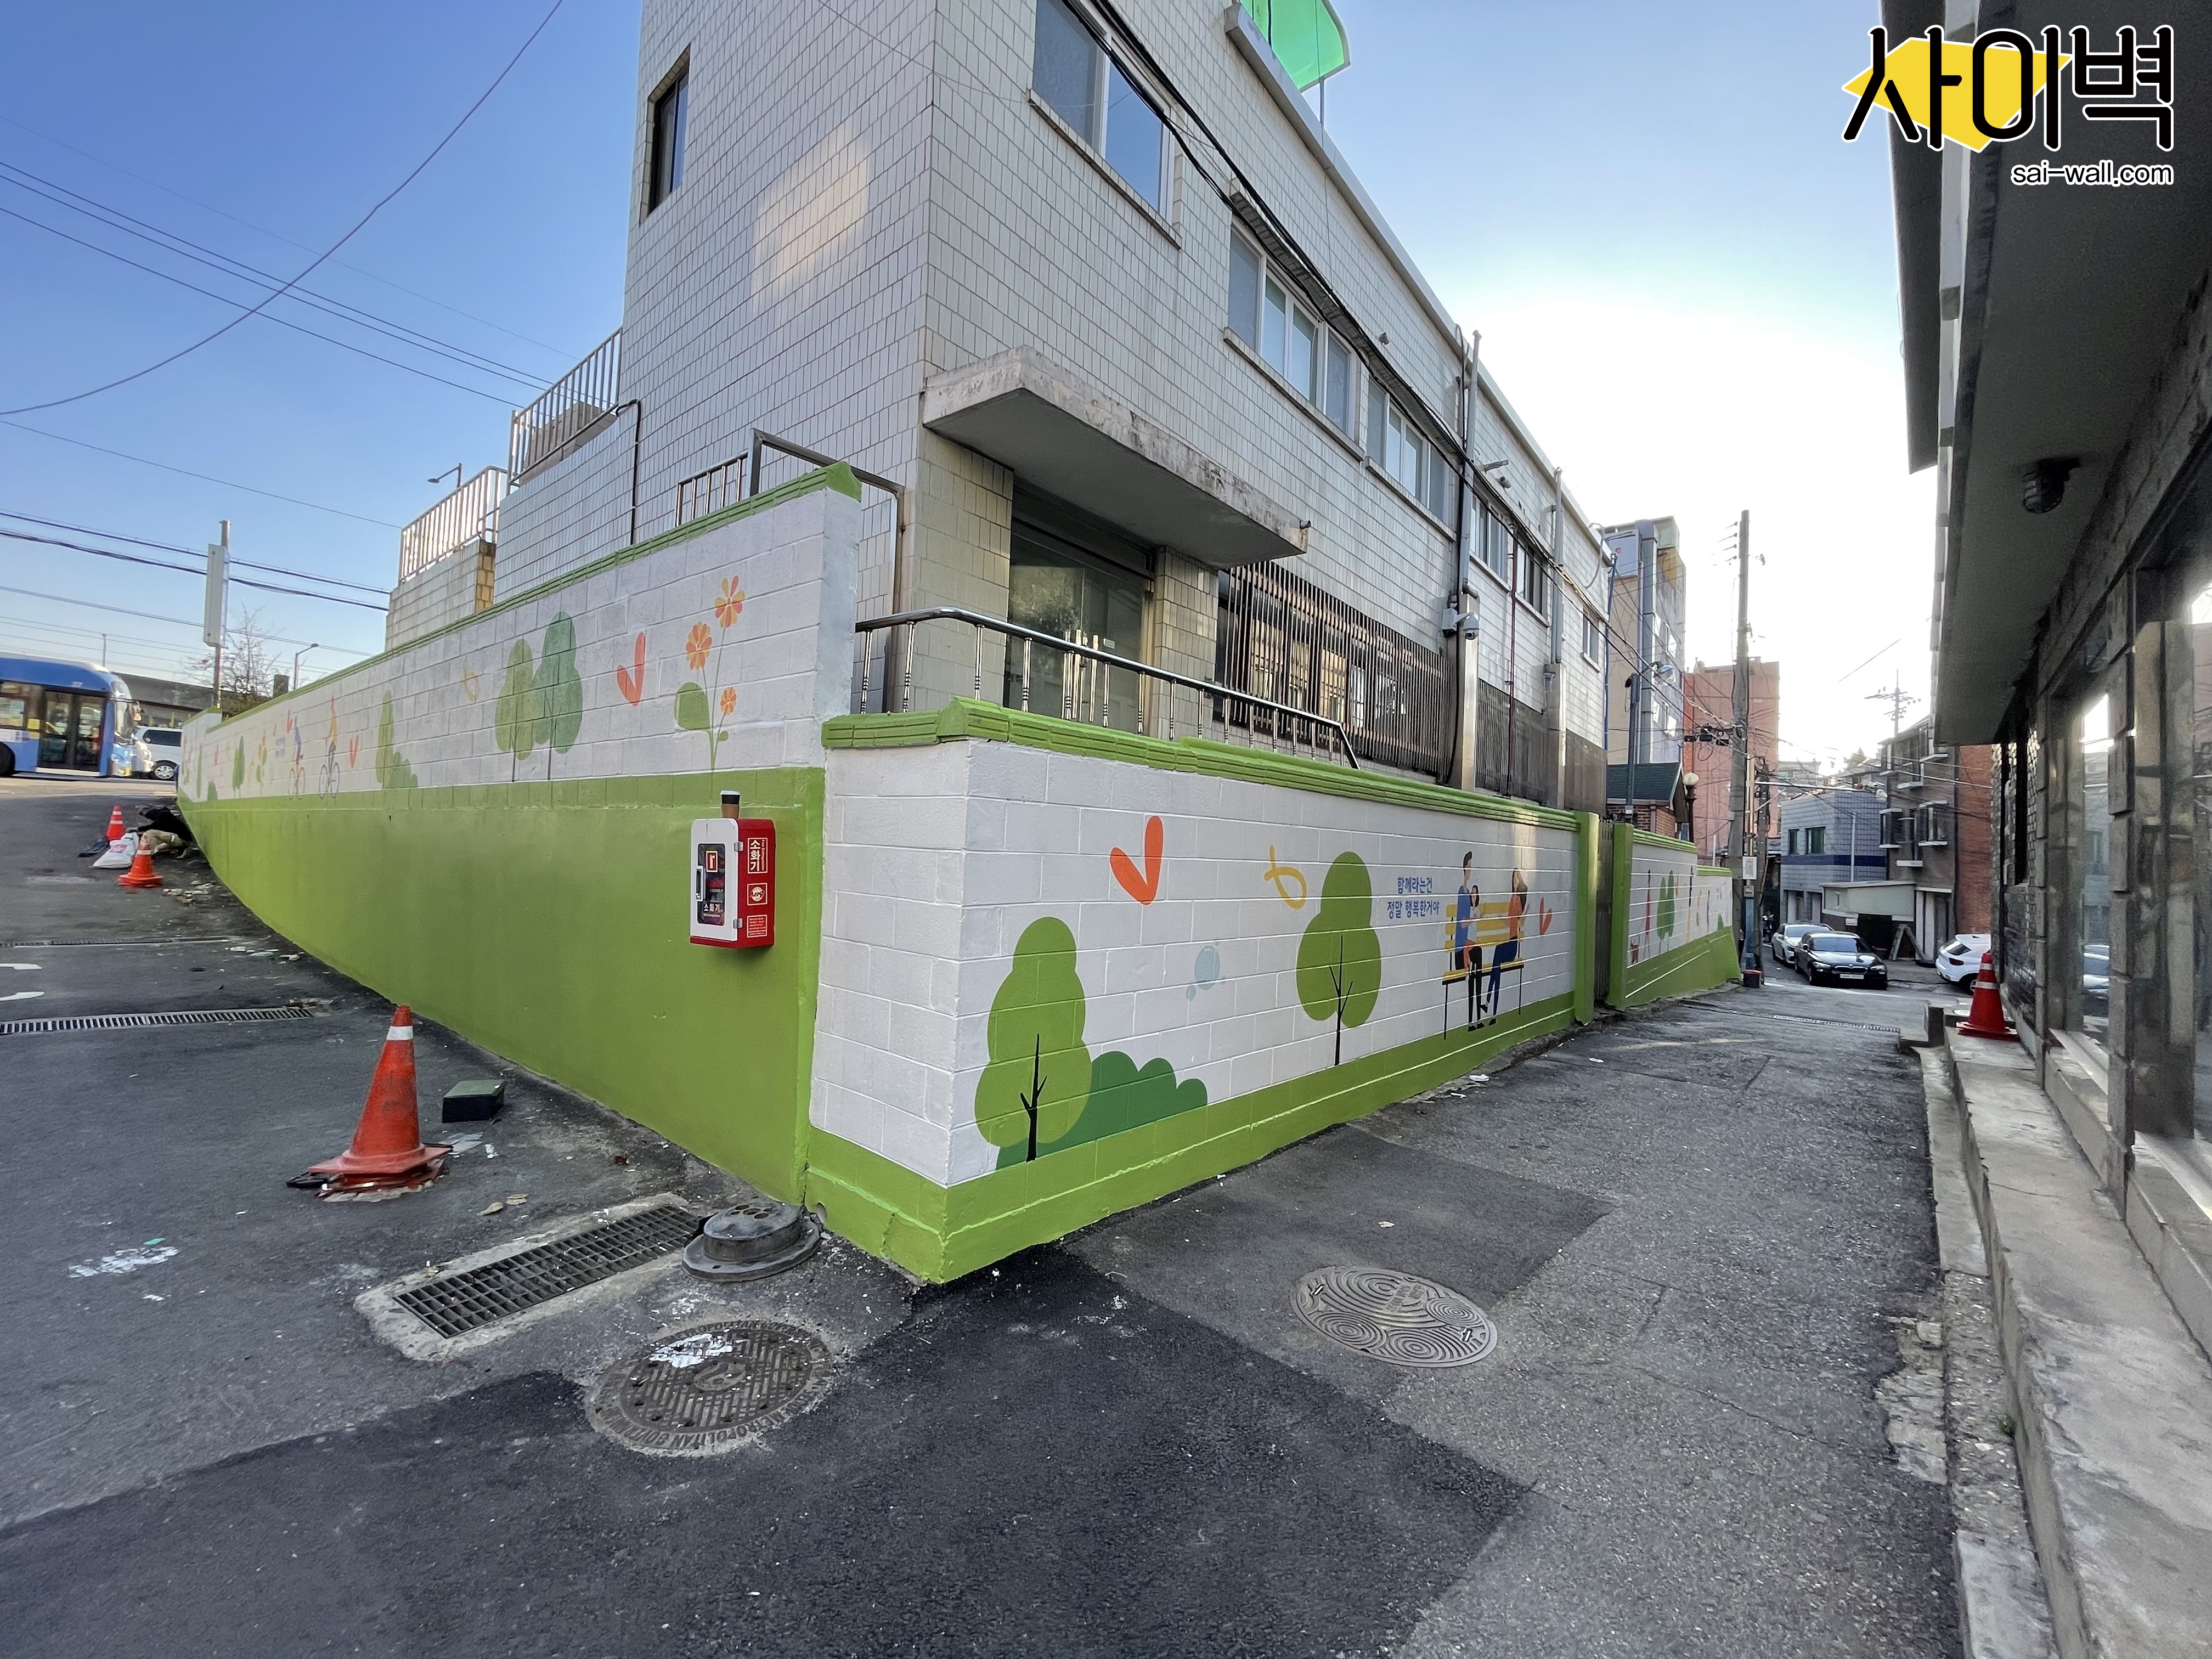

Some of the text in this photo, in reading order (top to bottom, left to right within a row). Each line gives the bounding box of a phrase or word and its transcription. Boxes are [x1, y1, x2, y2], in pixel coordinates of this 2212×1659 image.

[750, 839, 761, 871] 소화기
[1397, 876, 1432, 894] 함께라는건
[1387, 900, 1440, 919] 정말 행복한거야
